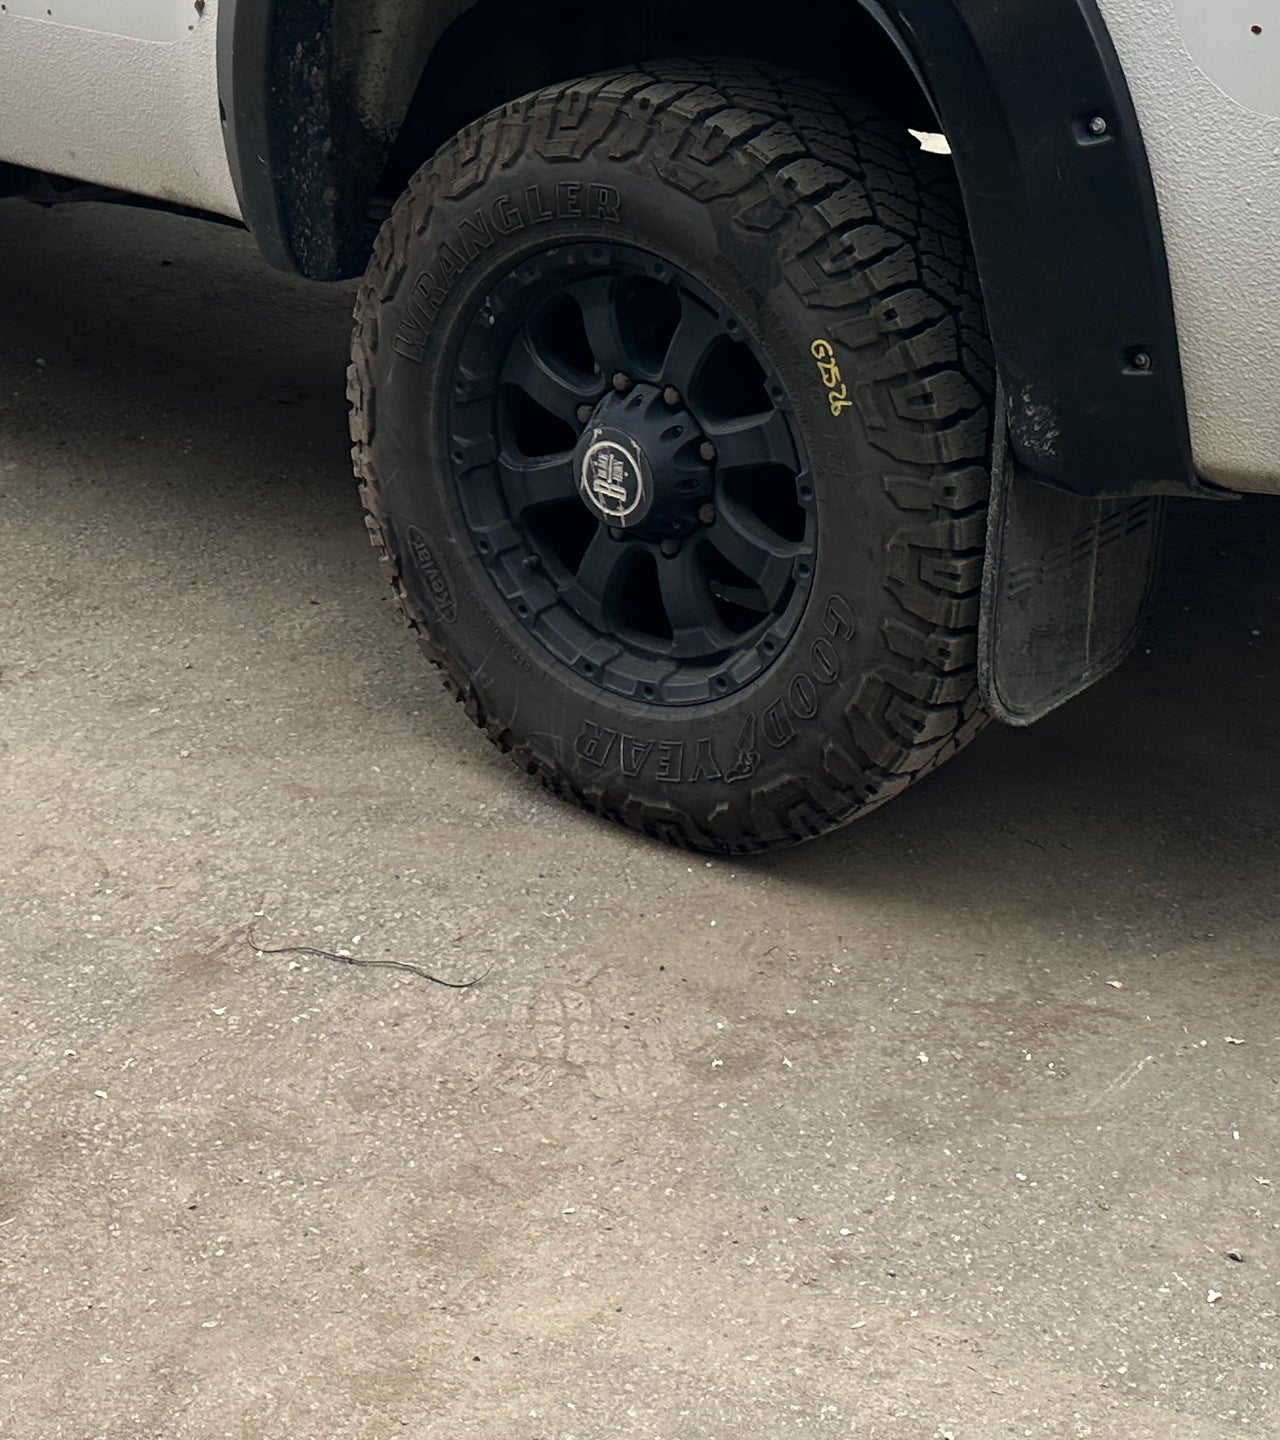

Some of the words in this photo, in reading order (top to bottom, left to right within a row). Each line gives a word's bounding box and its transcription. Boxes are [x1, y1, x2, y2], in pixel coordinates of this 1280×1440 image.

[392, 181, 621, 362] WRANGLER
[810, 339, 852, 416] G2526
[412, 540, 457, 615] Kevlar
[575, 594, 854, 783] GOODYEAR
